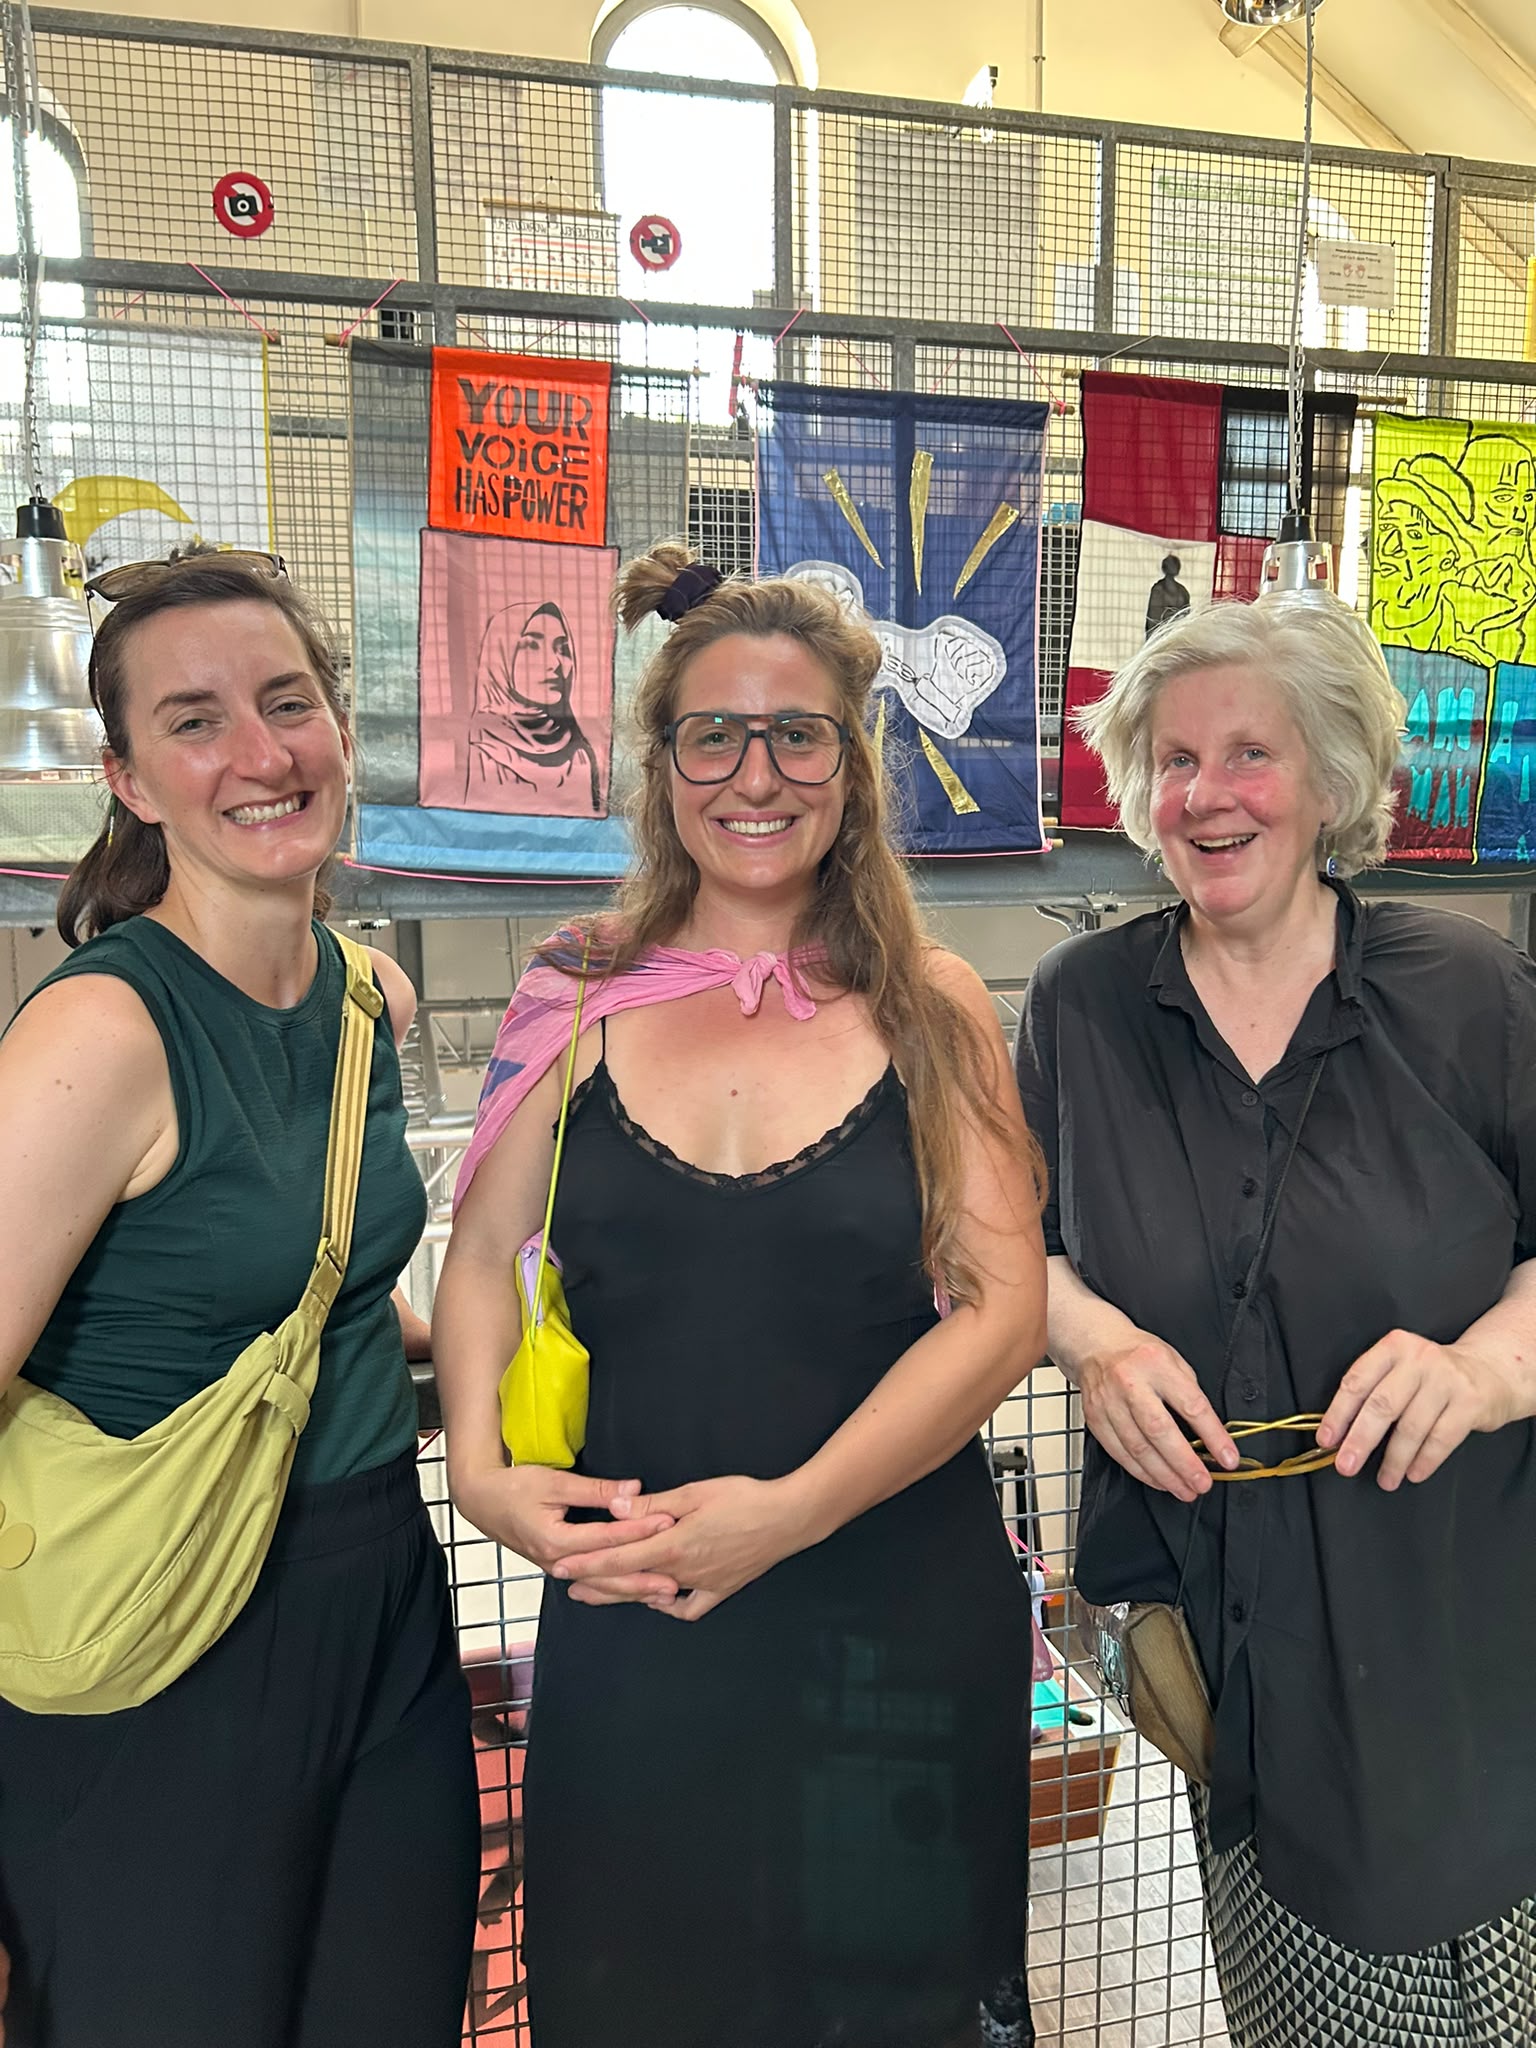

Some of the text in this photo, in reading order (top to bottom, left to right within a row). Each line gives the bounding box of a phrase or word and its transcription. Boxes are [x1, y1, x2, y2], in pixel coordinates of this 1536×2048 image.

[457, 378, 593, 440] YOUR
[455, 468, 588, 530] HAS POWER
